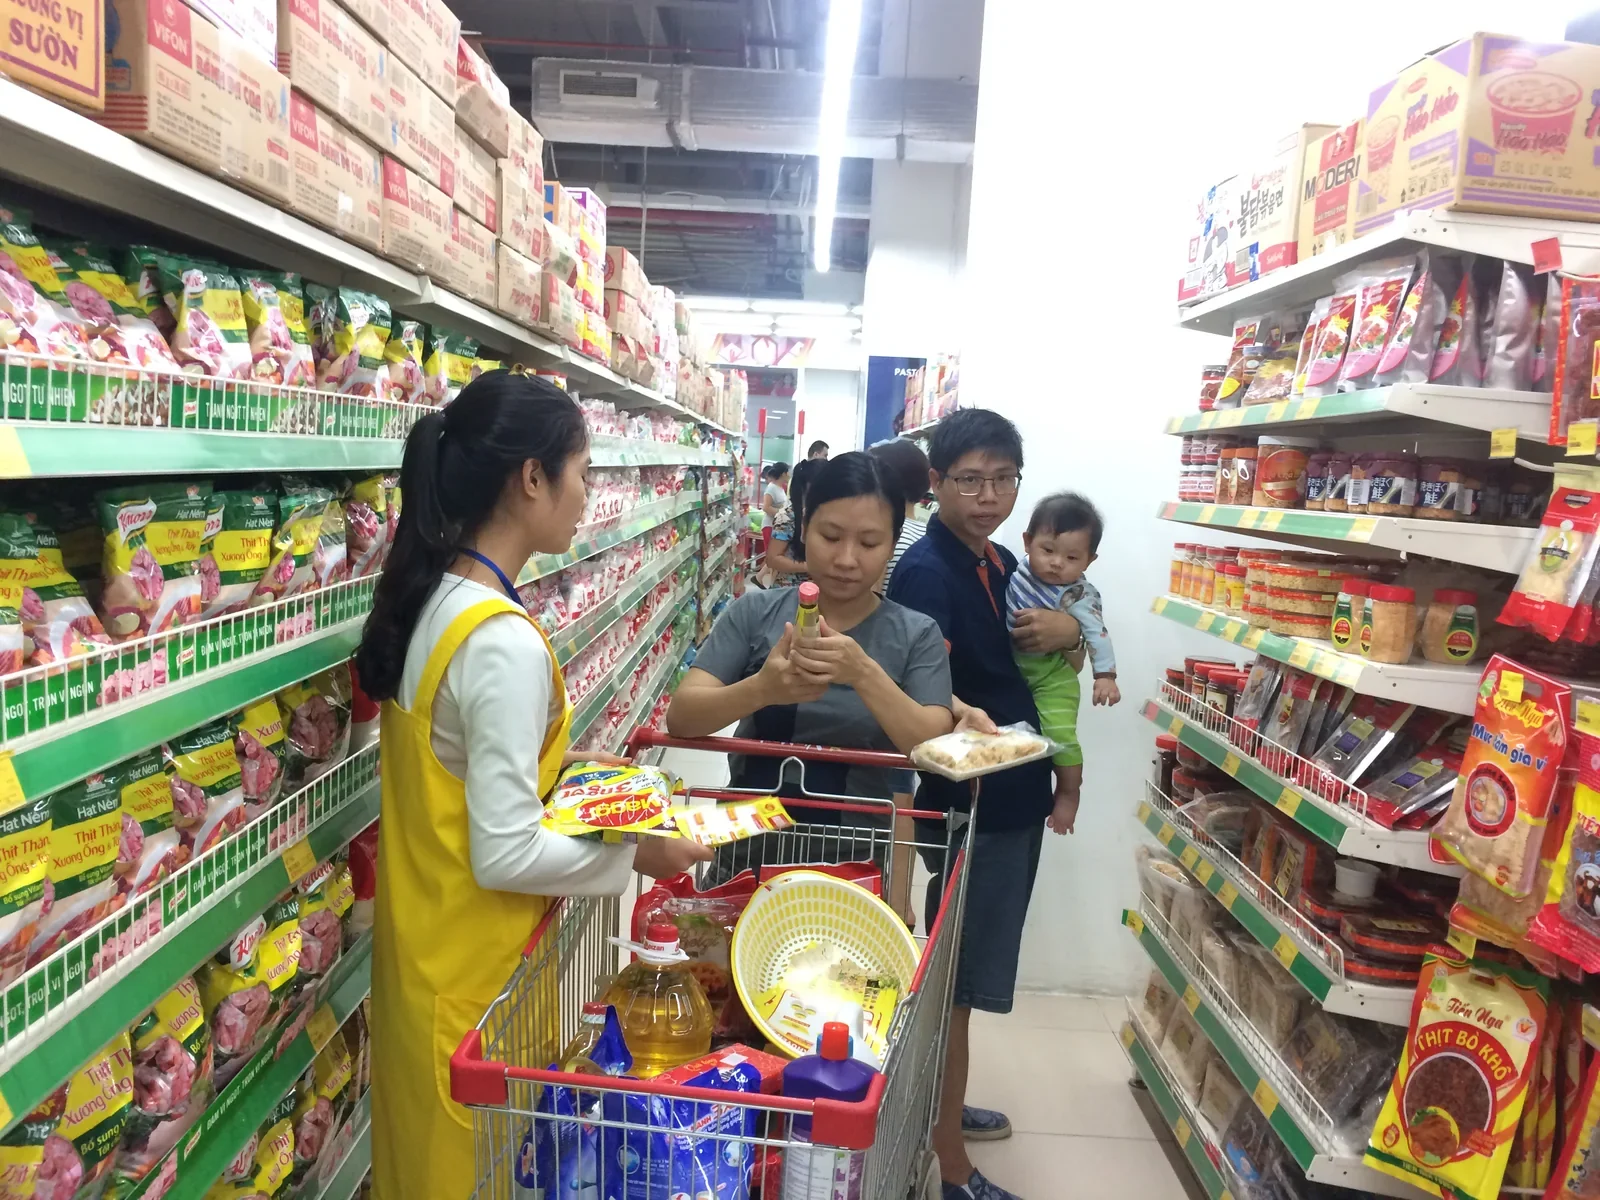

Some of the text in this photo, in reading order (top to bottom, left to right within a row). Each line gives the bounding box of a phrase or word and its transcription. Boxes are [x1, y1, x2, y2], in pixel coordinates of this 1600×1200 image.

[9, 18, 78, 70] SƯỜN
[153, 19, 188, 57] VIFON
[291, 119, 316, 143] VIFON
[387, 180, 408, 201] VIFON
[1237, 186, 1284, 239] 불닭볶음면
[119, 508, 153, 533] Knorr
[176, 508, 206, 519] Hạt Nêm
[204, 517, 220, 533] orr
[245, 518, 257, 529] Hạt
[36, 533, 58, 547] Nêm
[241, 537, 256, 549] Thịt
[221, 549, 263, 563] Xương Ống
[196, 729, 231, 747] Hạt Nêm
[256, 721, 281, 739] Xươn
[199, 753, 216, 765] Thịt
[1510, 747, 1531, 766] gia
[142, 763, 159, 777] Nêm
[136, 785, 151, 799] Thịt
[0, 810, 50, 833] Hạt Nêm
[77, 805, 97, 820] Hạt
[21, 836, 51, 853] Thăn
[75, 831, 97, 846] Thịt
[53, 852, 83, 870] Xương
[83, 843, 105, 860] Ống
[6, 863, 30, 878] Ống
[301, 861, 333, 892] Knorr
[1447, 997, 1504, 1030] Tiến Nga
[1417, 1028, 1512, 1081] THỊT BÒ KHÔ
[84, 1061, 109, 1086] Thịt
[64, 1094, 106, 1128] Xương
[281, 1099, 296, 1114] Nê
[80, 1125, 120, 1156] Bổ sung
[268, 1134, 290, 1154] Thịt
